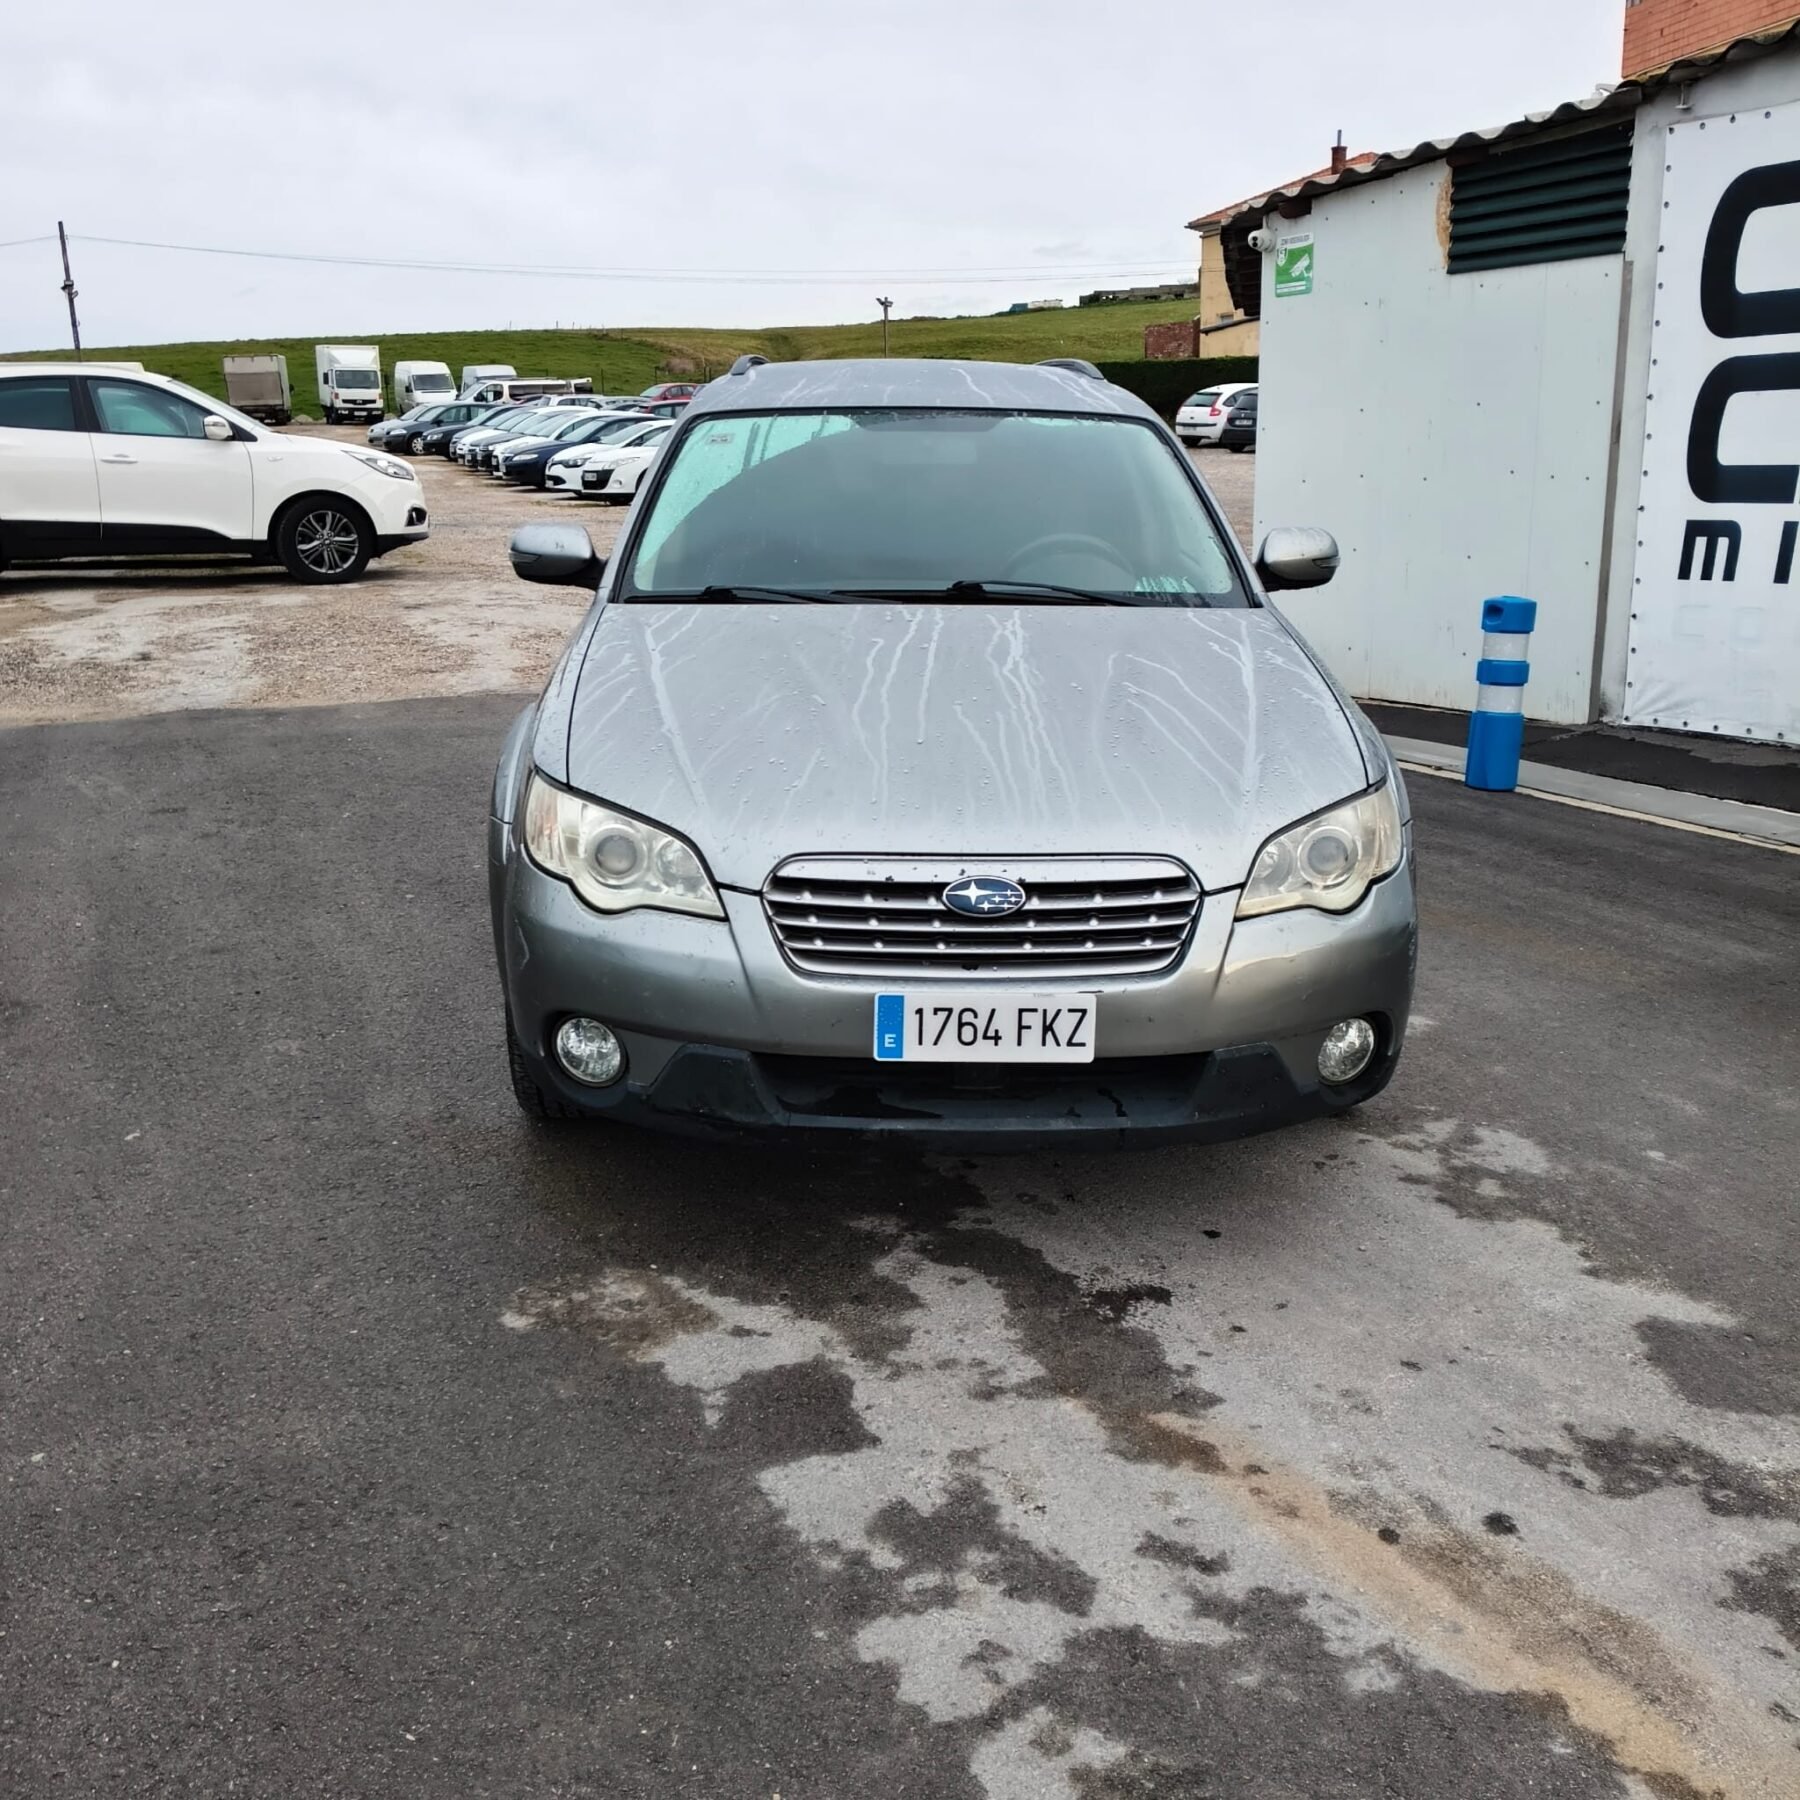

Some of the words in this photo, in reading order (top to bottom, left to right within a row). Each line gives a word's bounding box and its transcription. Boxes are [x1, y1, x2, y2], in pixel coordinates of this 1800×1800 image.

[884, 1033, 897, 1048] E
[914, 1007, 1003, 1047] 1764
[1016, 1007, 1088, 1047] FKZ
